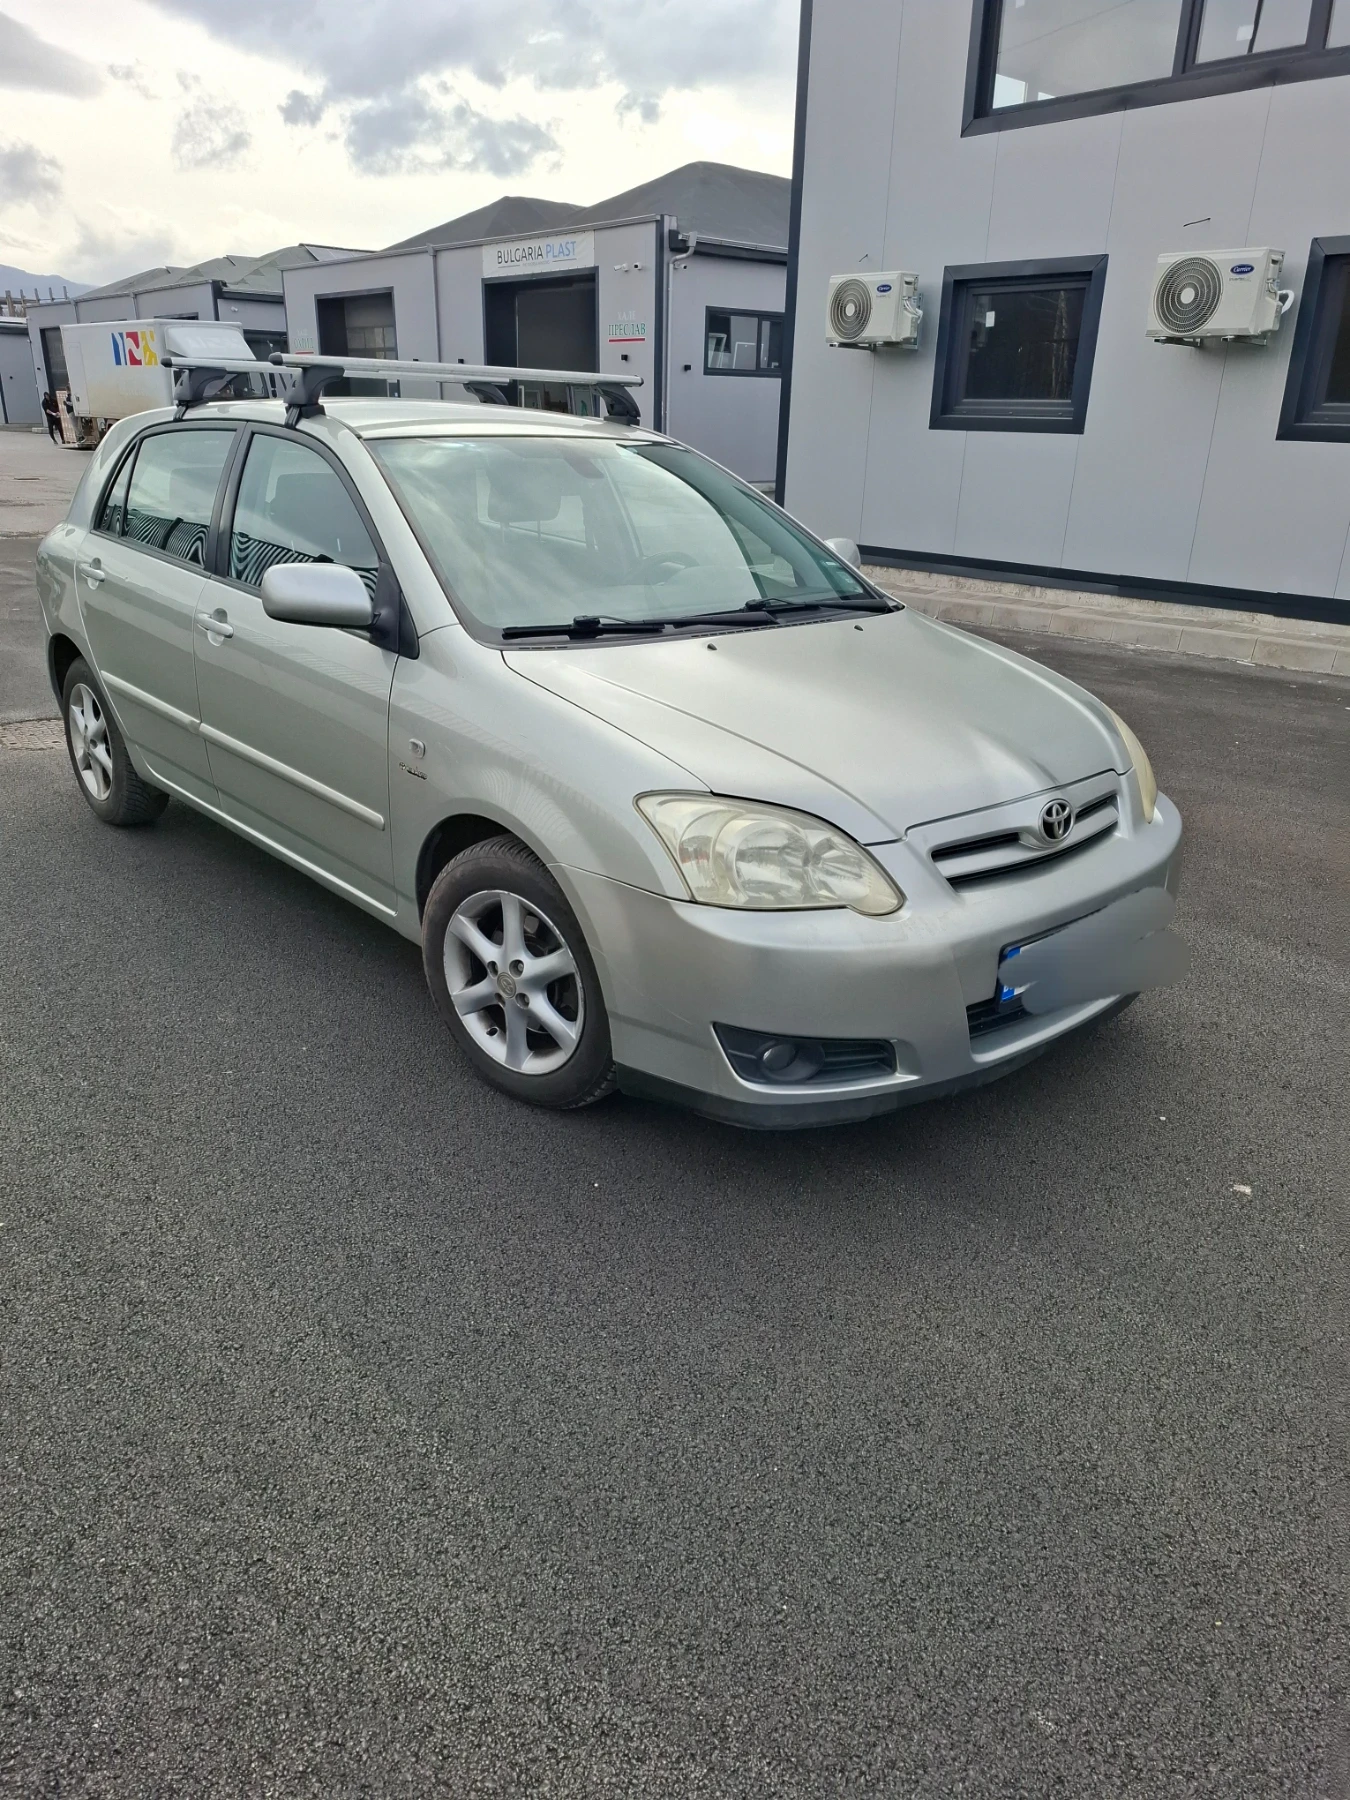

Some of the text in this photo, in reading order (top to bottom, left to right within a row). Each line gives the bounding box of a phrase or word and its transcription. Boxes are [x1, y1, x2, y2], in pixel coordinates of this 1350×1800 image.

[497, 241, 577, 265] BULGARIA PLAST
[608, 322, 646, 336] ПРЕСЛАВ
